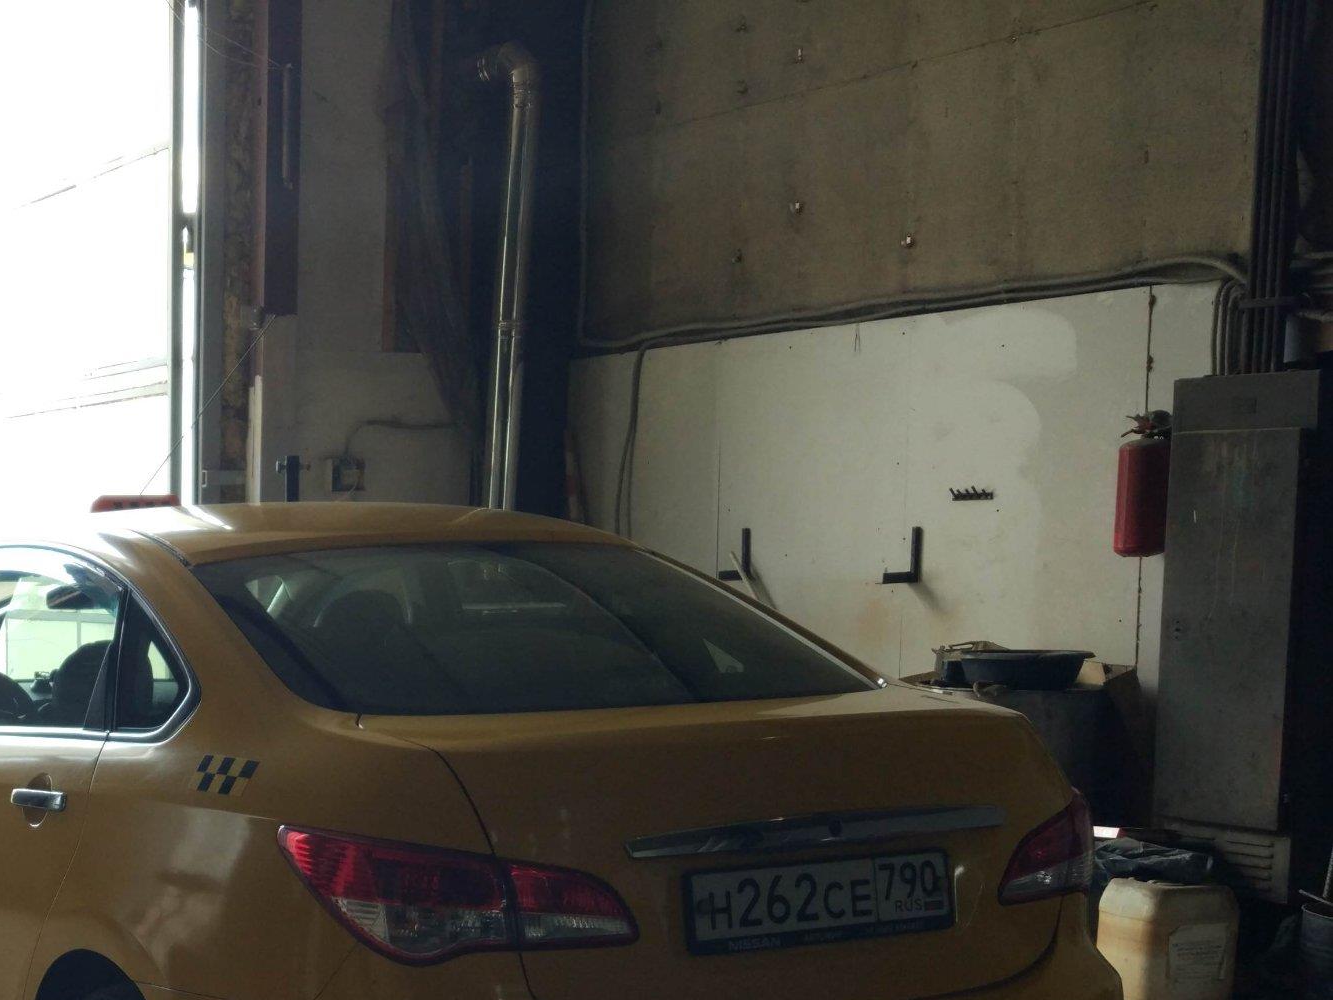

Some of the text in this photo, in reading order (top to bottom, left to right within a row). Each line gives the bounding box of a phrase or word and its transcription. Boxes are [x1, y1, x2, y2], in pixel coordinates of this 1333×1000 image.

[878, 859, 940, 900] 790
[895, 898, 924, 914] RUS
[728, 935, 782, 951] NISSAN
